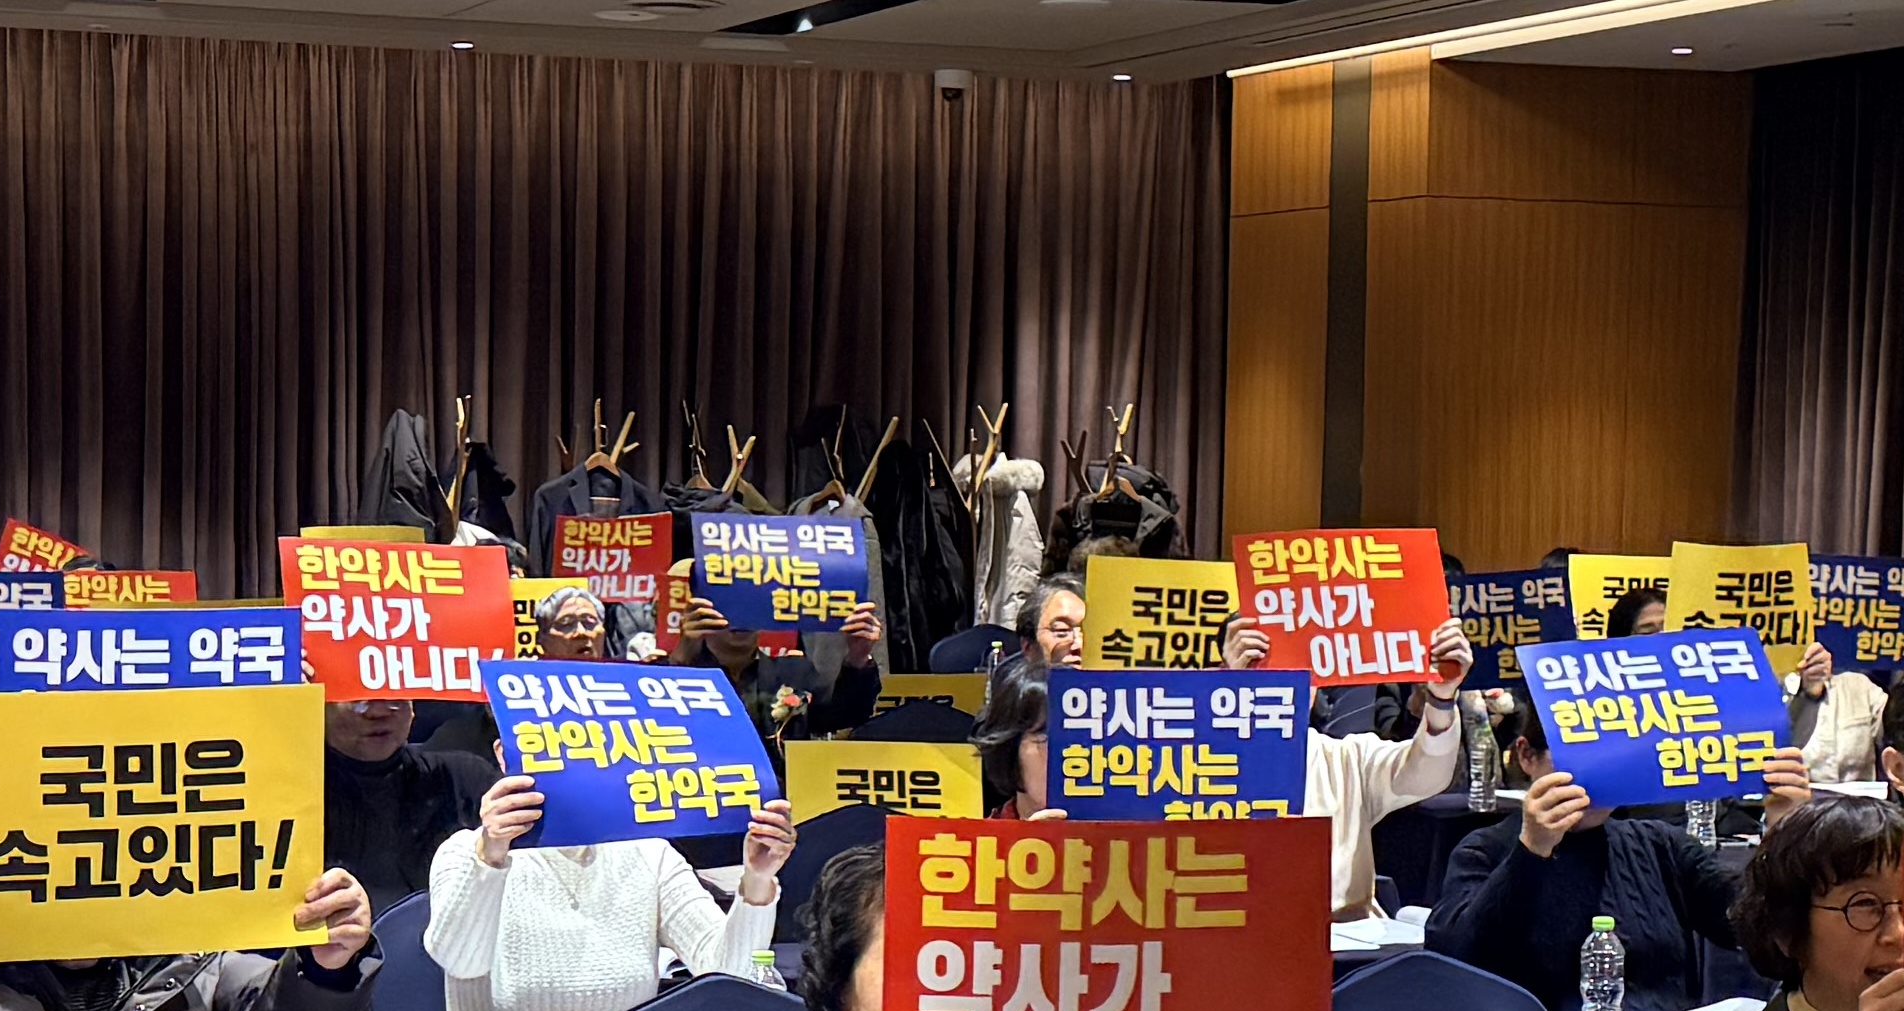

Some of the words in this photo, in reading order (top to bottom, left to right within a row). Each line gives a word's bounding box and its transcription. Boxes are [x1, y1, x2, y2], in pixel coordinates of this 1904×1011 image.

[564, 519, 653, 547] 한약사는
[701, 522, 789, 553] 약사는
[797, 524, 854, 555] 약국
[295, 544, 464, 595] 한약사는
[562, 547, 632, 573] 약사가
[704, 553, 821, 586] 한약사는
[1247, 536, 1404, 585] 한약사는
[1808, 563, 1880, 597] 약사는
[63, 574, 172, 607] 한약사는
[772, 588, 857, 622] 한약국
[1132, 586, 1230, 627] 국민은
[1254, 584, 1375, 632] 약사가
[1521, 576, 1566, 609] 약국
[1715, 570, 1795, 609] 국민은
[301, 594, 431, 642] 약사가
[12, 627, 171, 685] 약사는
[189, 626, 285, 684] 약국
[358, 644, 504, 693] 아니다
[1536, 650, 1667, 695] 약사는
[1671, 640, 1760, 683] 약국
[497, 673, 632, 718] 약사는
[639, 677, 732, 718] 약국
[1061, 687, 1195, 740] 약사는
[1210, 687, 1295, 739] 약국
[1550, 688, 1722, 743] 한약사는
[513, 720, 697, 773] 한약사는
[1061, 744, 1239, 797] 한약사는
[1655, 730, 1776, 788] 한약국
[39, 739, 246, 819] 국민은
[627, 763, 763, 824] 한약국
[836, 769, 942, 809] 국민은
[918, 832, 1249, 931] 한약사는
